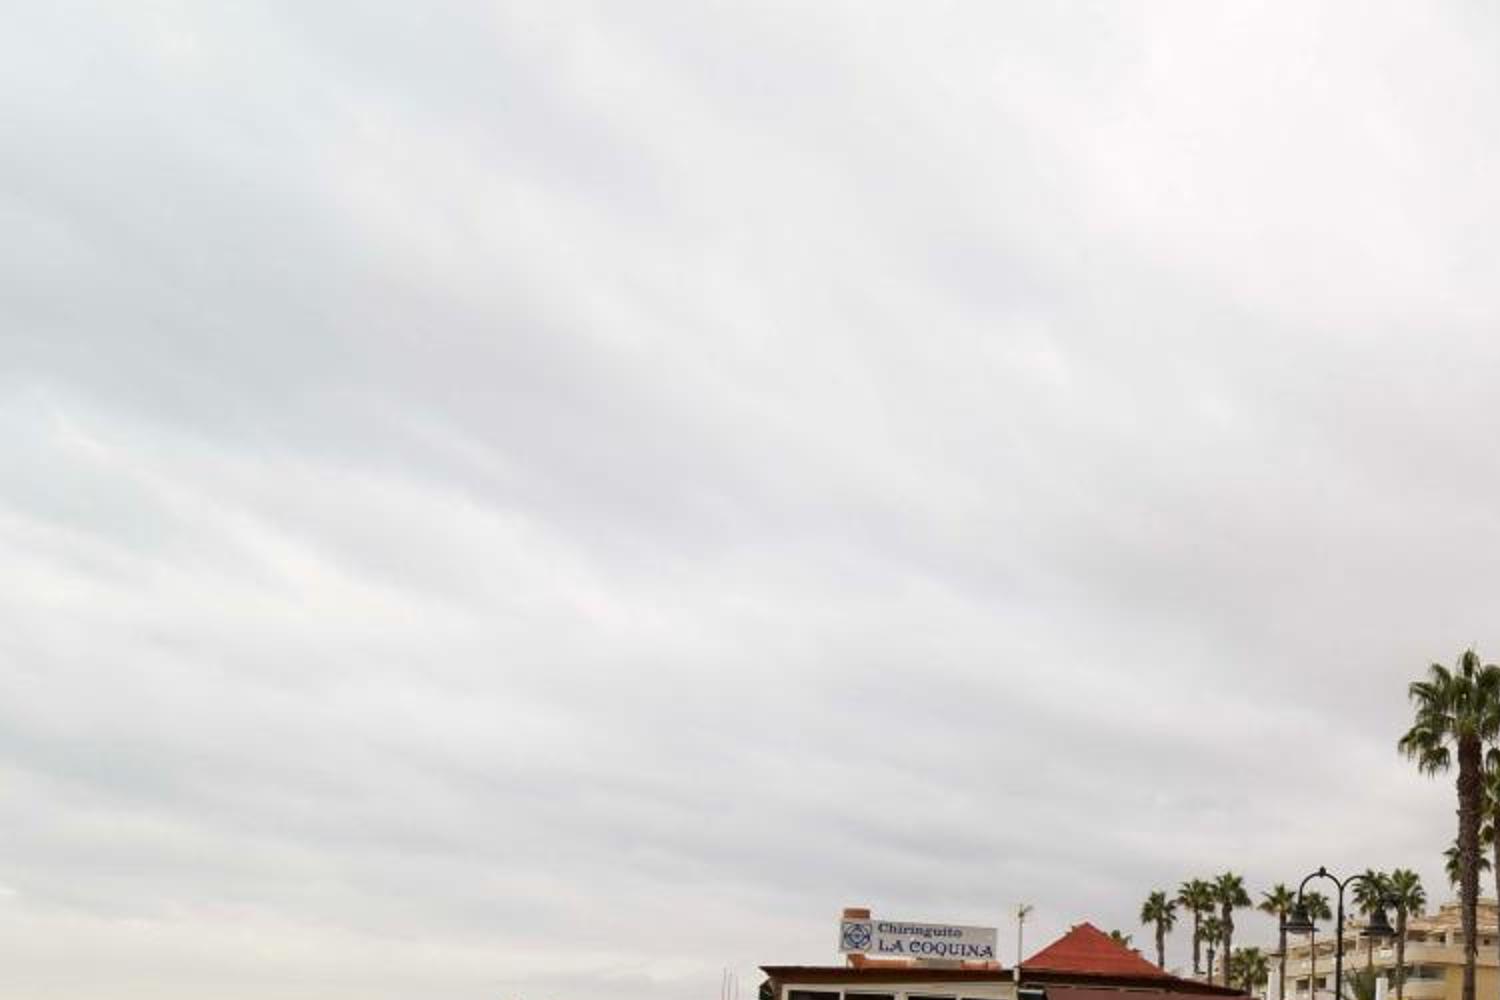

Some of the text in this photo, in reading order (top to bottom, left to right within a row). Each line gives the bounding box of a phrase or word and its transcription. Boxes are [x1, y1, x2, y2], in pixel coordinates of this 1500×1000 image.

[878, 923, 963, 939] Chiringuito
[879, 939, 993, 958] LA COQUINA
